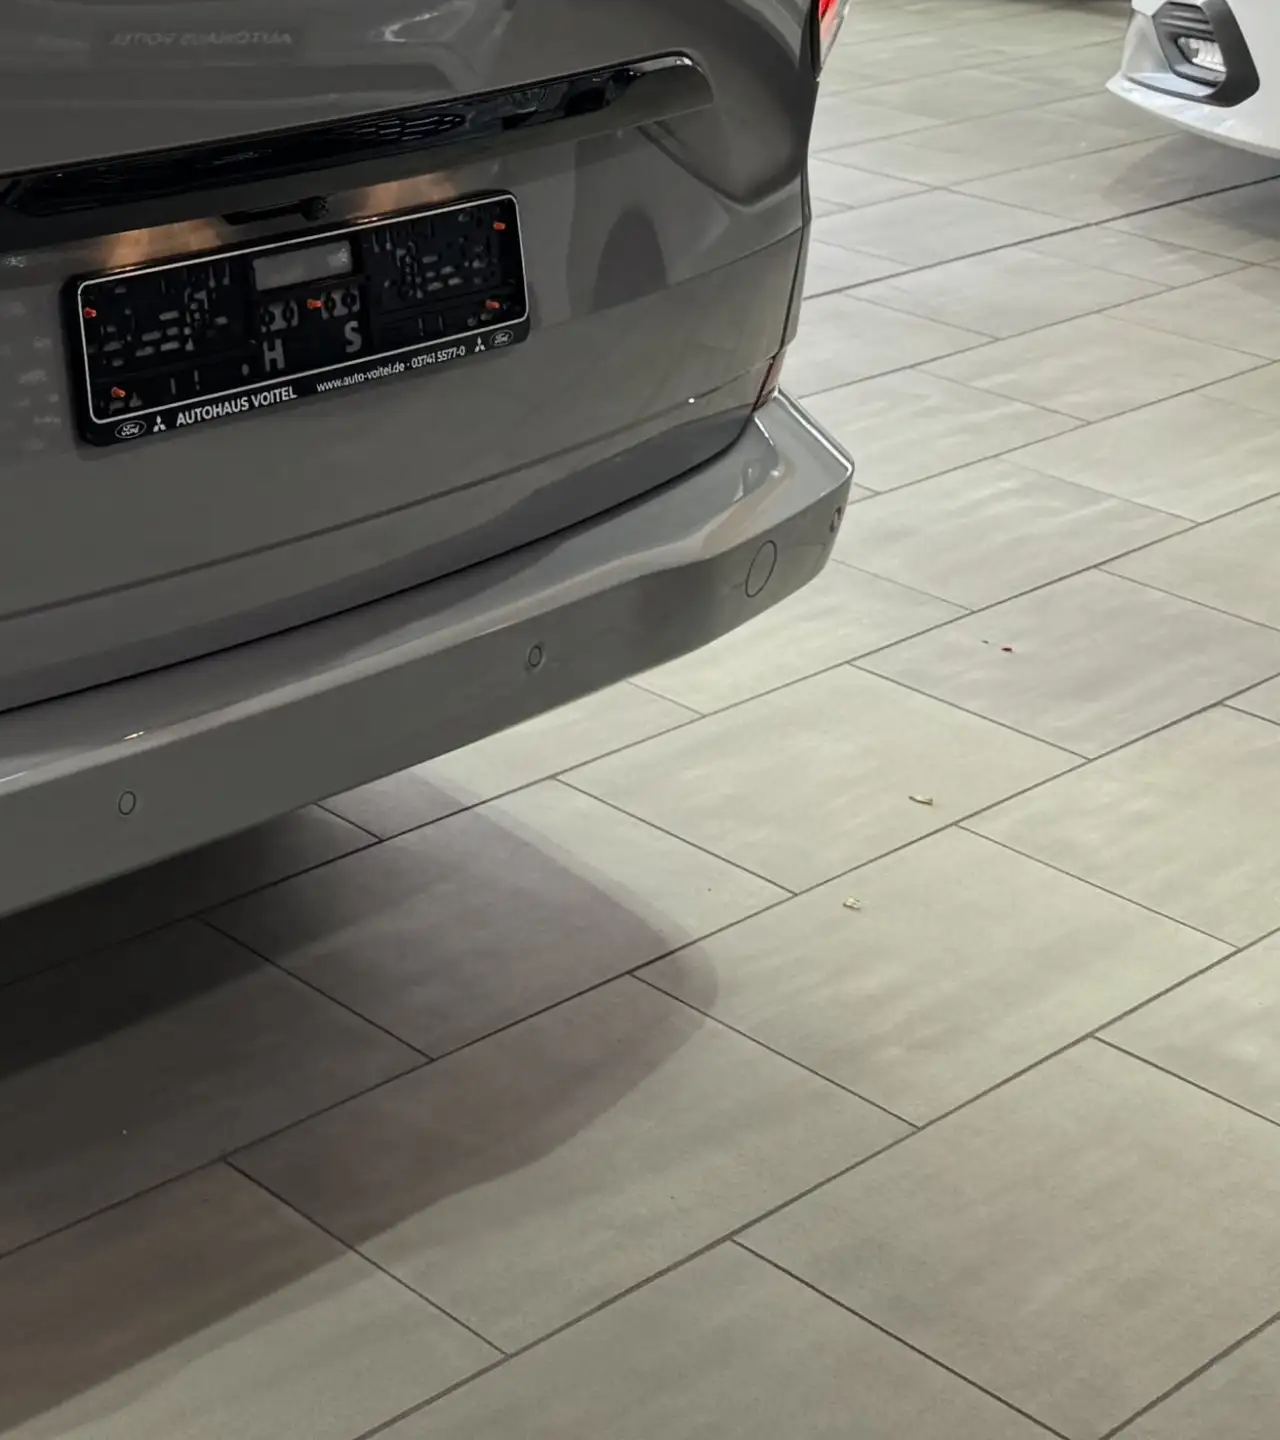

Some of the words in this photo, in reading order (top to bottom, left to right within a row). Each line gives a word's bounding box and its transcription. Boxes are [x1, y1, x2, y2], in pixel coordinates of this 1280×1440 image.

[316, 361, 405, 393] www.auto-voitel.de
[411, 351, 436, 369] 03741
[176, 396, 249, 427] AUTOHAUS
[251, 386, 298, 408] VOITEL
